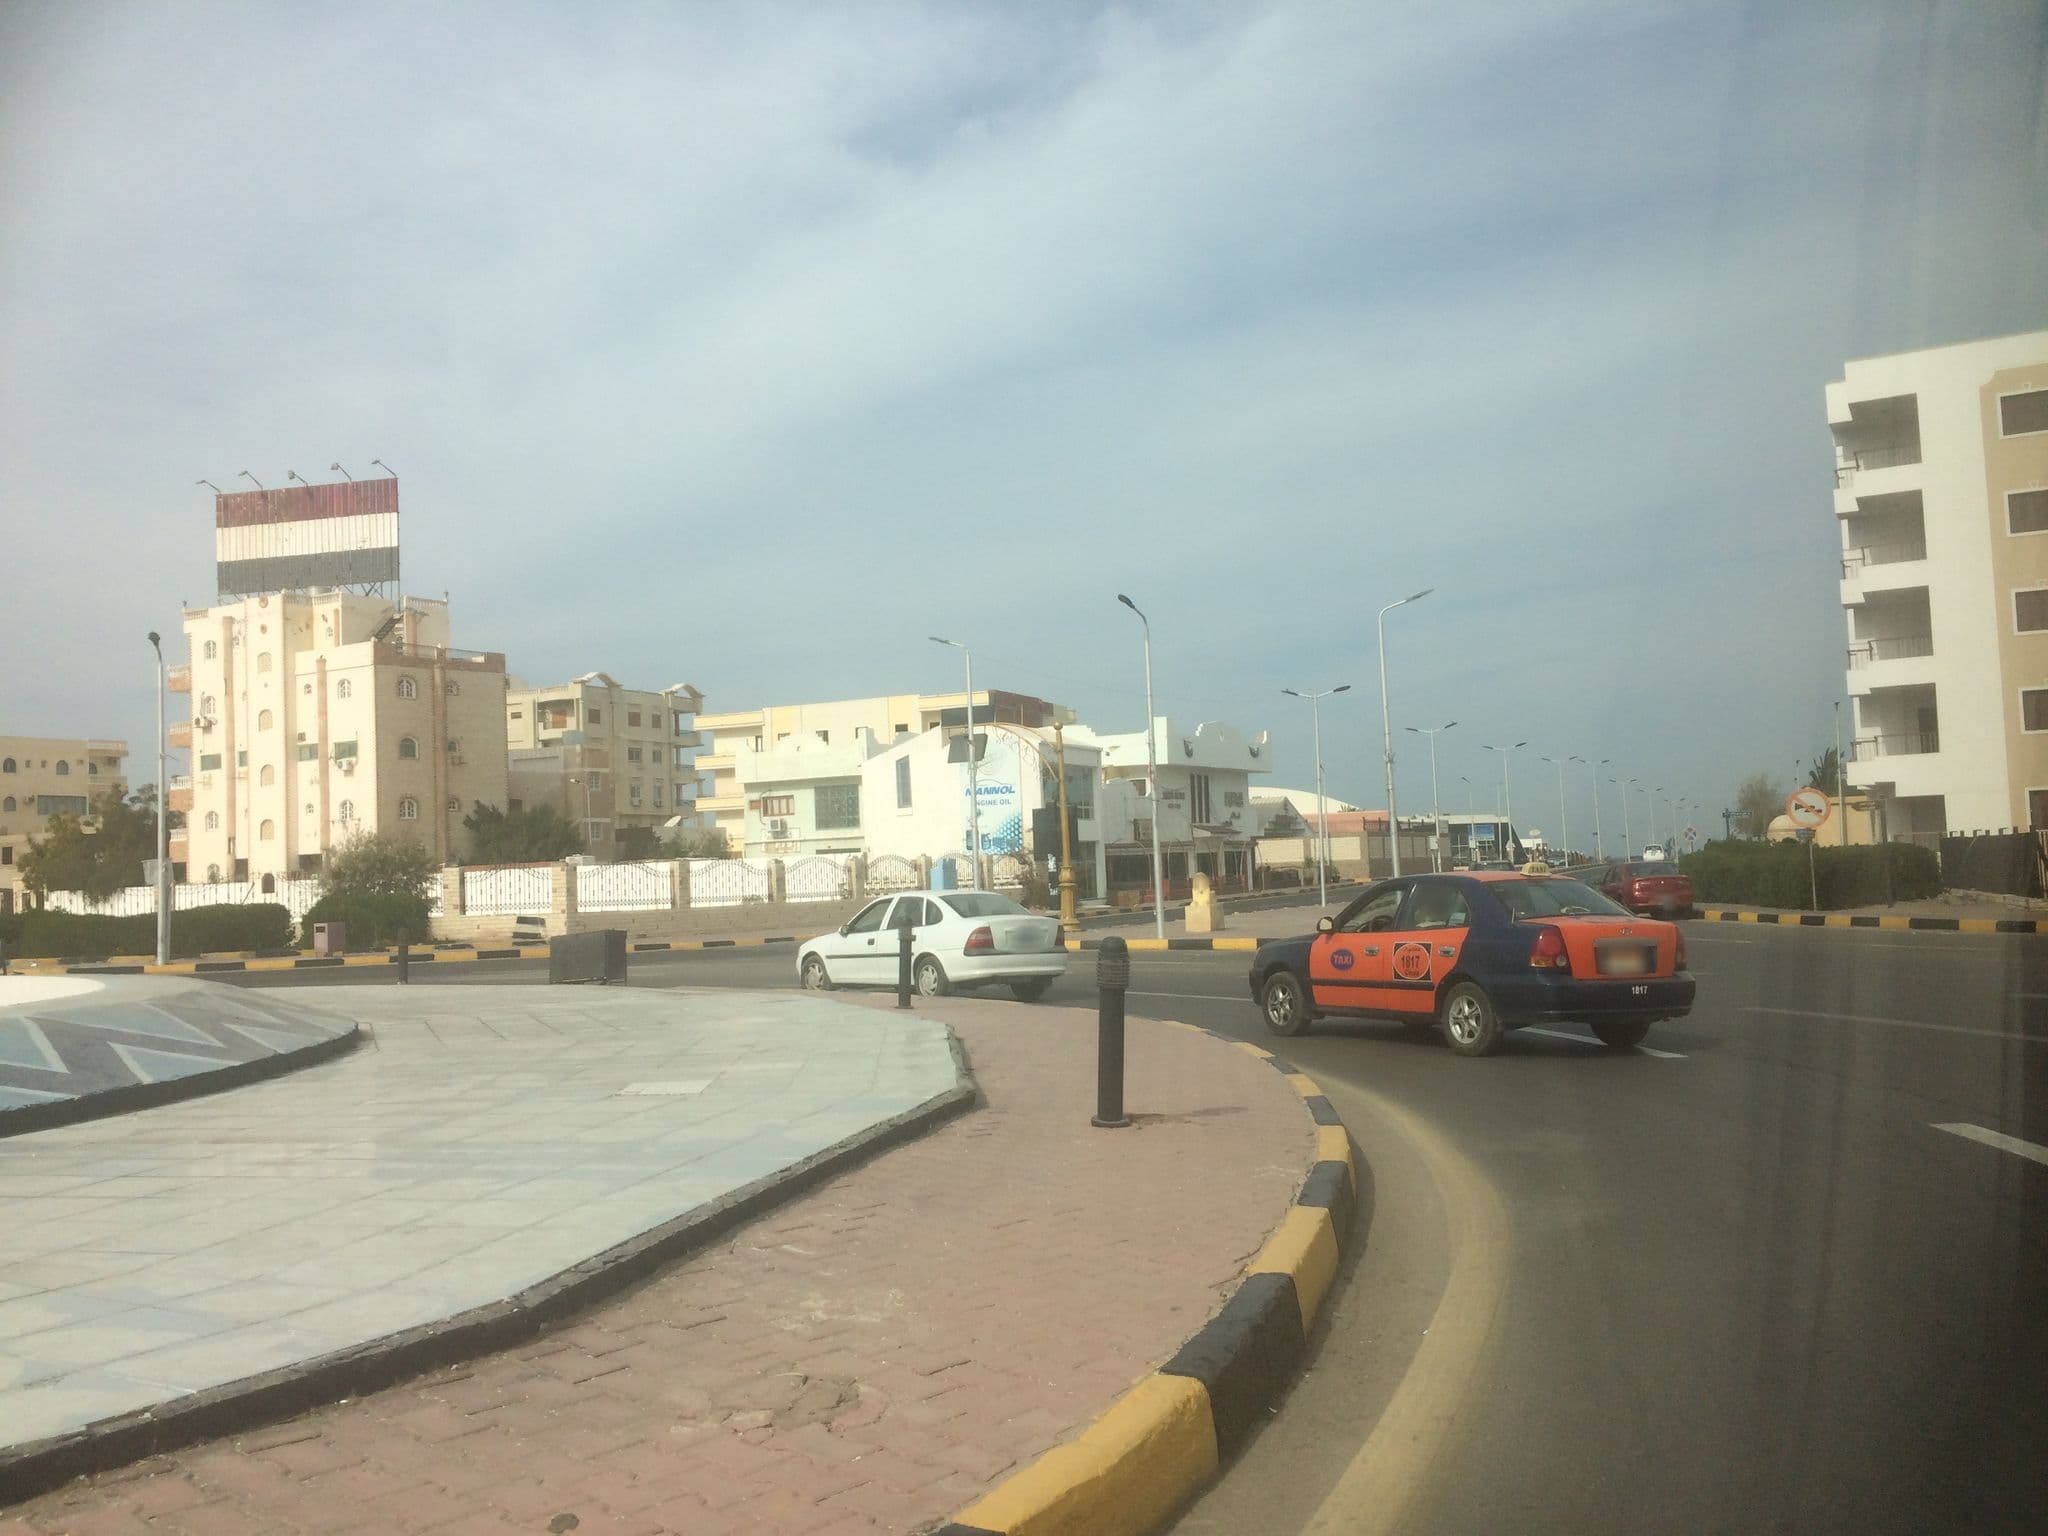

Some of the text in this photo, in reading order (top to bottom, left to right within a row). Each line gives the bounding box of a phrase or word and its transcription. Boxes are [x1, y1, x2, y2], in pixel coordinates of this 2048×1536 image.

[1333, 954, 1353, 966] TAXI
[1401, 955, 1420, 969] 1817
[1631, 985, 1648, 995] 1817
